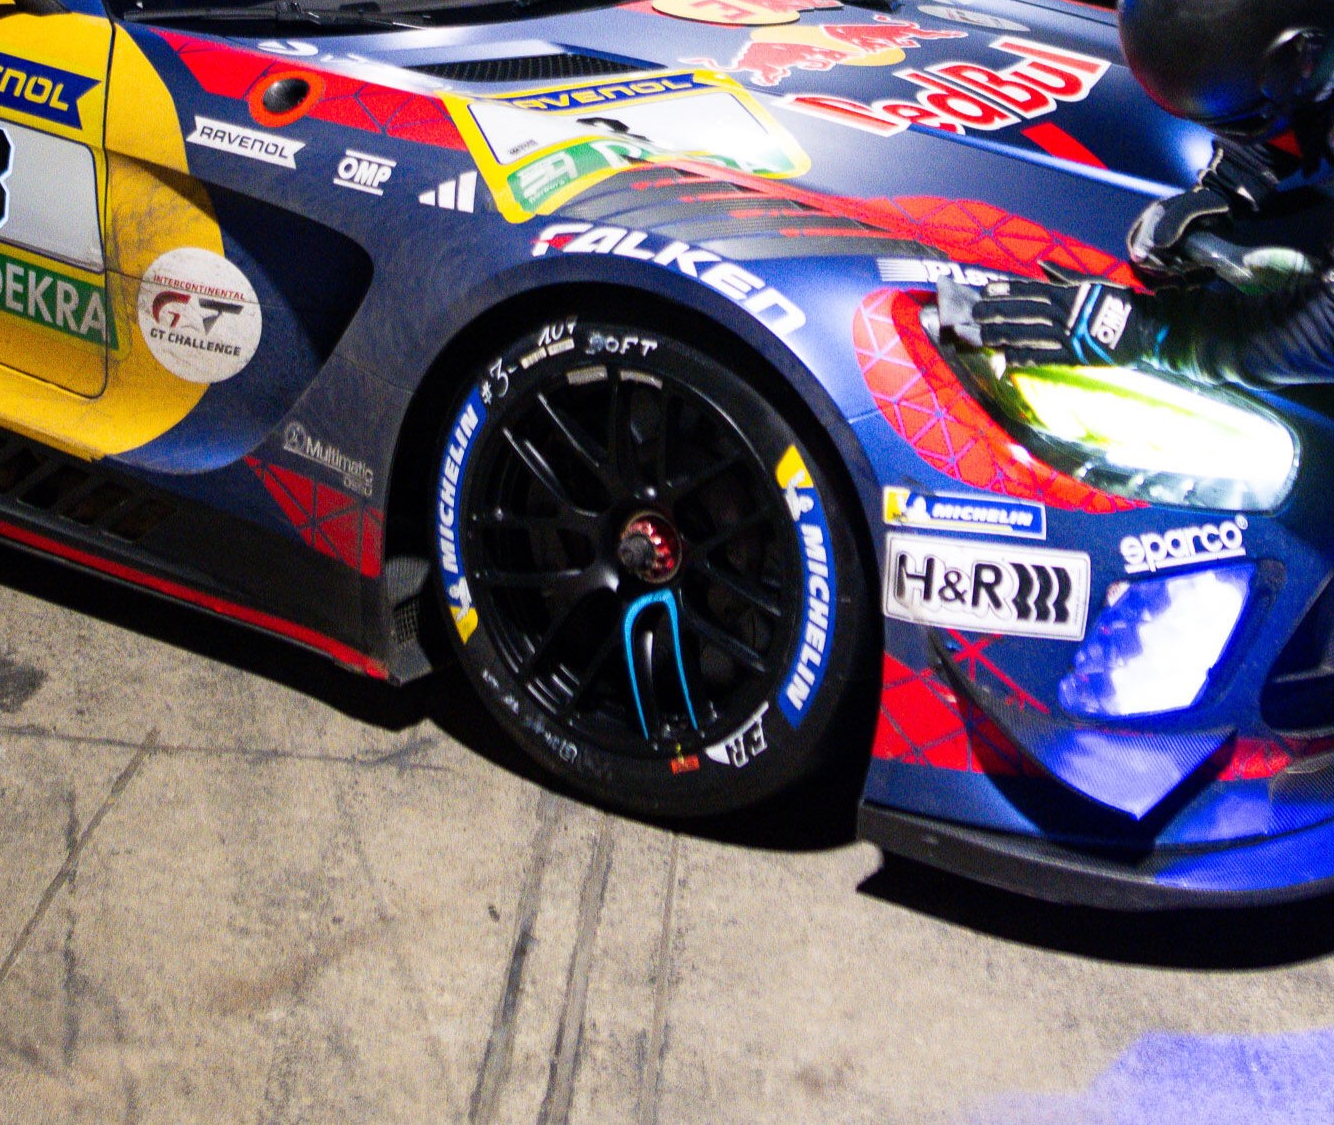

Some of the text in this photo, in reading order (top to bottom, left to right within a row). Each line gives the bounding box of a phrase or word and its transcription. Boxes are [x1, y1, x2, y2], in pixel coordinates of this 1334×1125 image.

[198, 125, 289, 160] RAVENOL
[337, 157, 392, 188] OMP
[153, 273, 246, 302] INTERCONTINENTAL
[149, 328, 242, 357] GT CHALLENGE
[436, 404, 479, 573] MICHELIN
[932, 501, 1034, 528] MICHELIN
[896, 551, 1004, 611] H&R
[784, 523, 832, 711] MICHELIN
